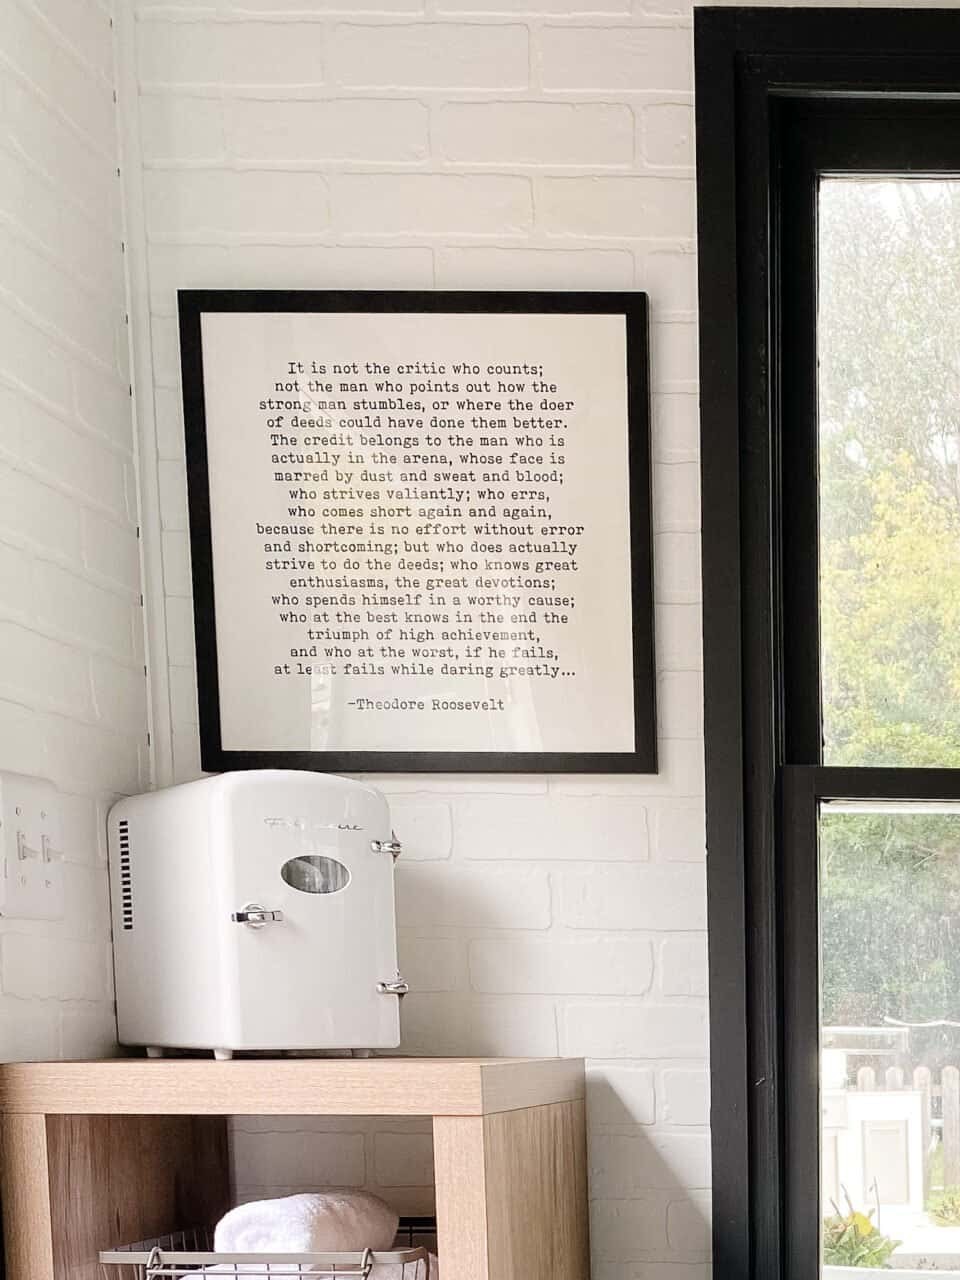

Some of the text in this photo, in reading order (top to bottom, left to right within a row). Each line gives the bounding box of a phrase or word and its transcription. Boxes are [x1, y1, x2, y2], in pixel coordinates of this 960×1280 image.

[288, 362, 542, 377] It is not the critic who counts;
[275, 380, 557, 396] not the man who points out how the
[259, 398, 574, 413] strong man stumbles, or where the doer
[267, 416, 567, 428] of deeds could have done them better.
[270, 434, 564, 450] The credit belongs to the man who is
[272, 451, 565, 467] actually in the arena, whose face is
[274, 469, 563, 485] marred by dust and sweat and blood;
[289, 487, 549, 503] who strives valiantly; who errs,
[288, 505, 551, 521] who comes short again and again,
[256, 523, 584, 536] because there is no effort without error
[264, 540, 577, 556] and shortcoming; but who does actually
[266, 558, 578, 574] strive to do the deeds; who knows great
[290, 576, 555, 592] enthusiasms, the great devotions;
[272, 593, 574, 609] who spends himself in a worthy cause;
[280, 611, 568, 624] who at the best knows in the end the
[307, 628, 540, 644] triumph of high achievement,
[290, 646, 558, 661] and who at the worst, if he fails,
[274, 663, 291, 676] at
[344, 663, 384, 676] fails
[391, 663, 434, 676] while
[441, 663, 493, 679] daring
[432, 698, 504, 711] Roosevelt
